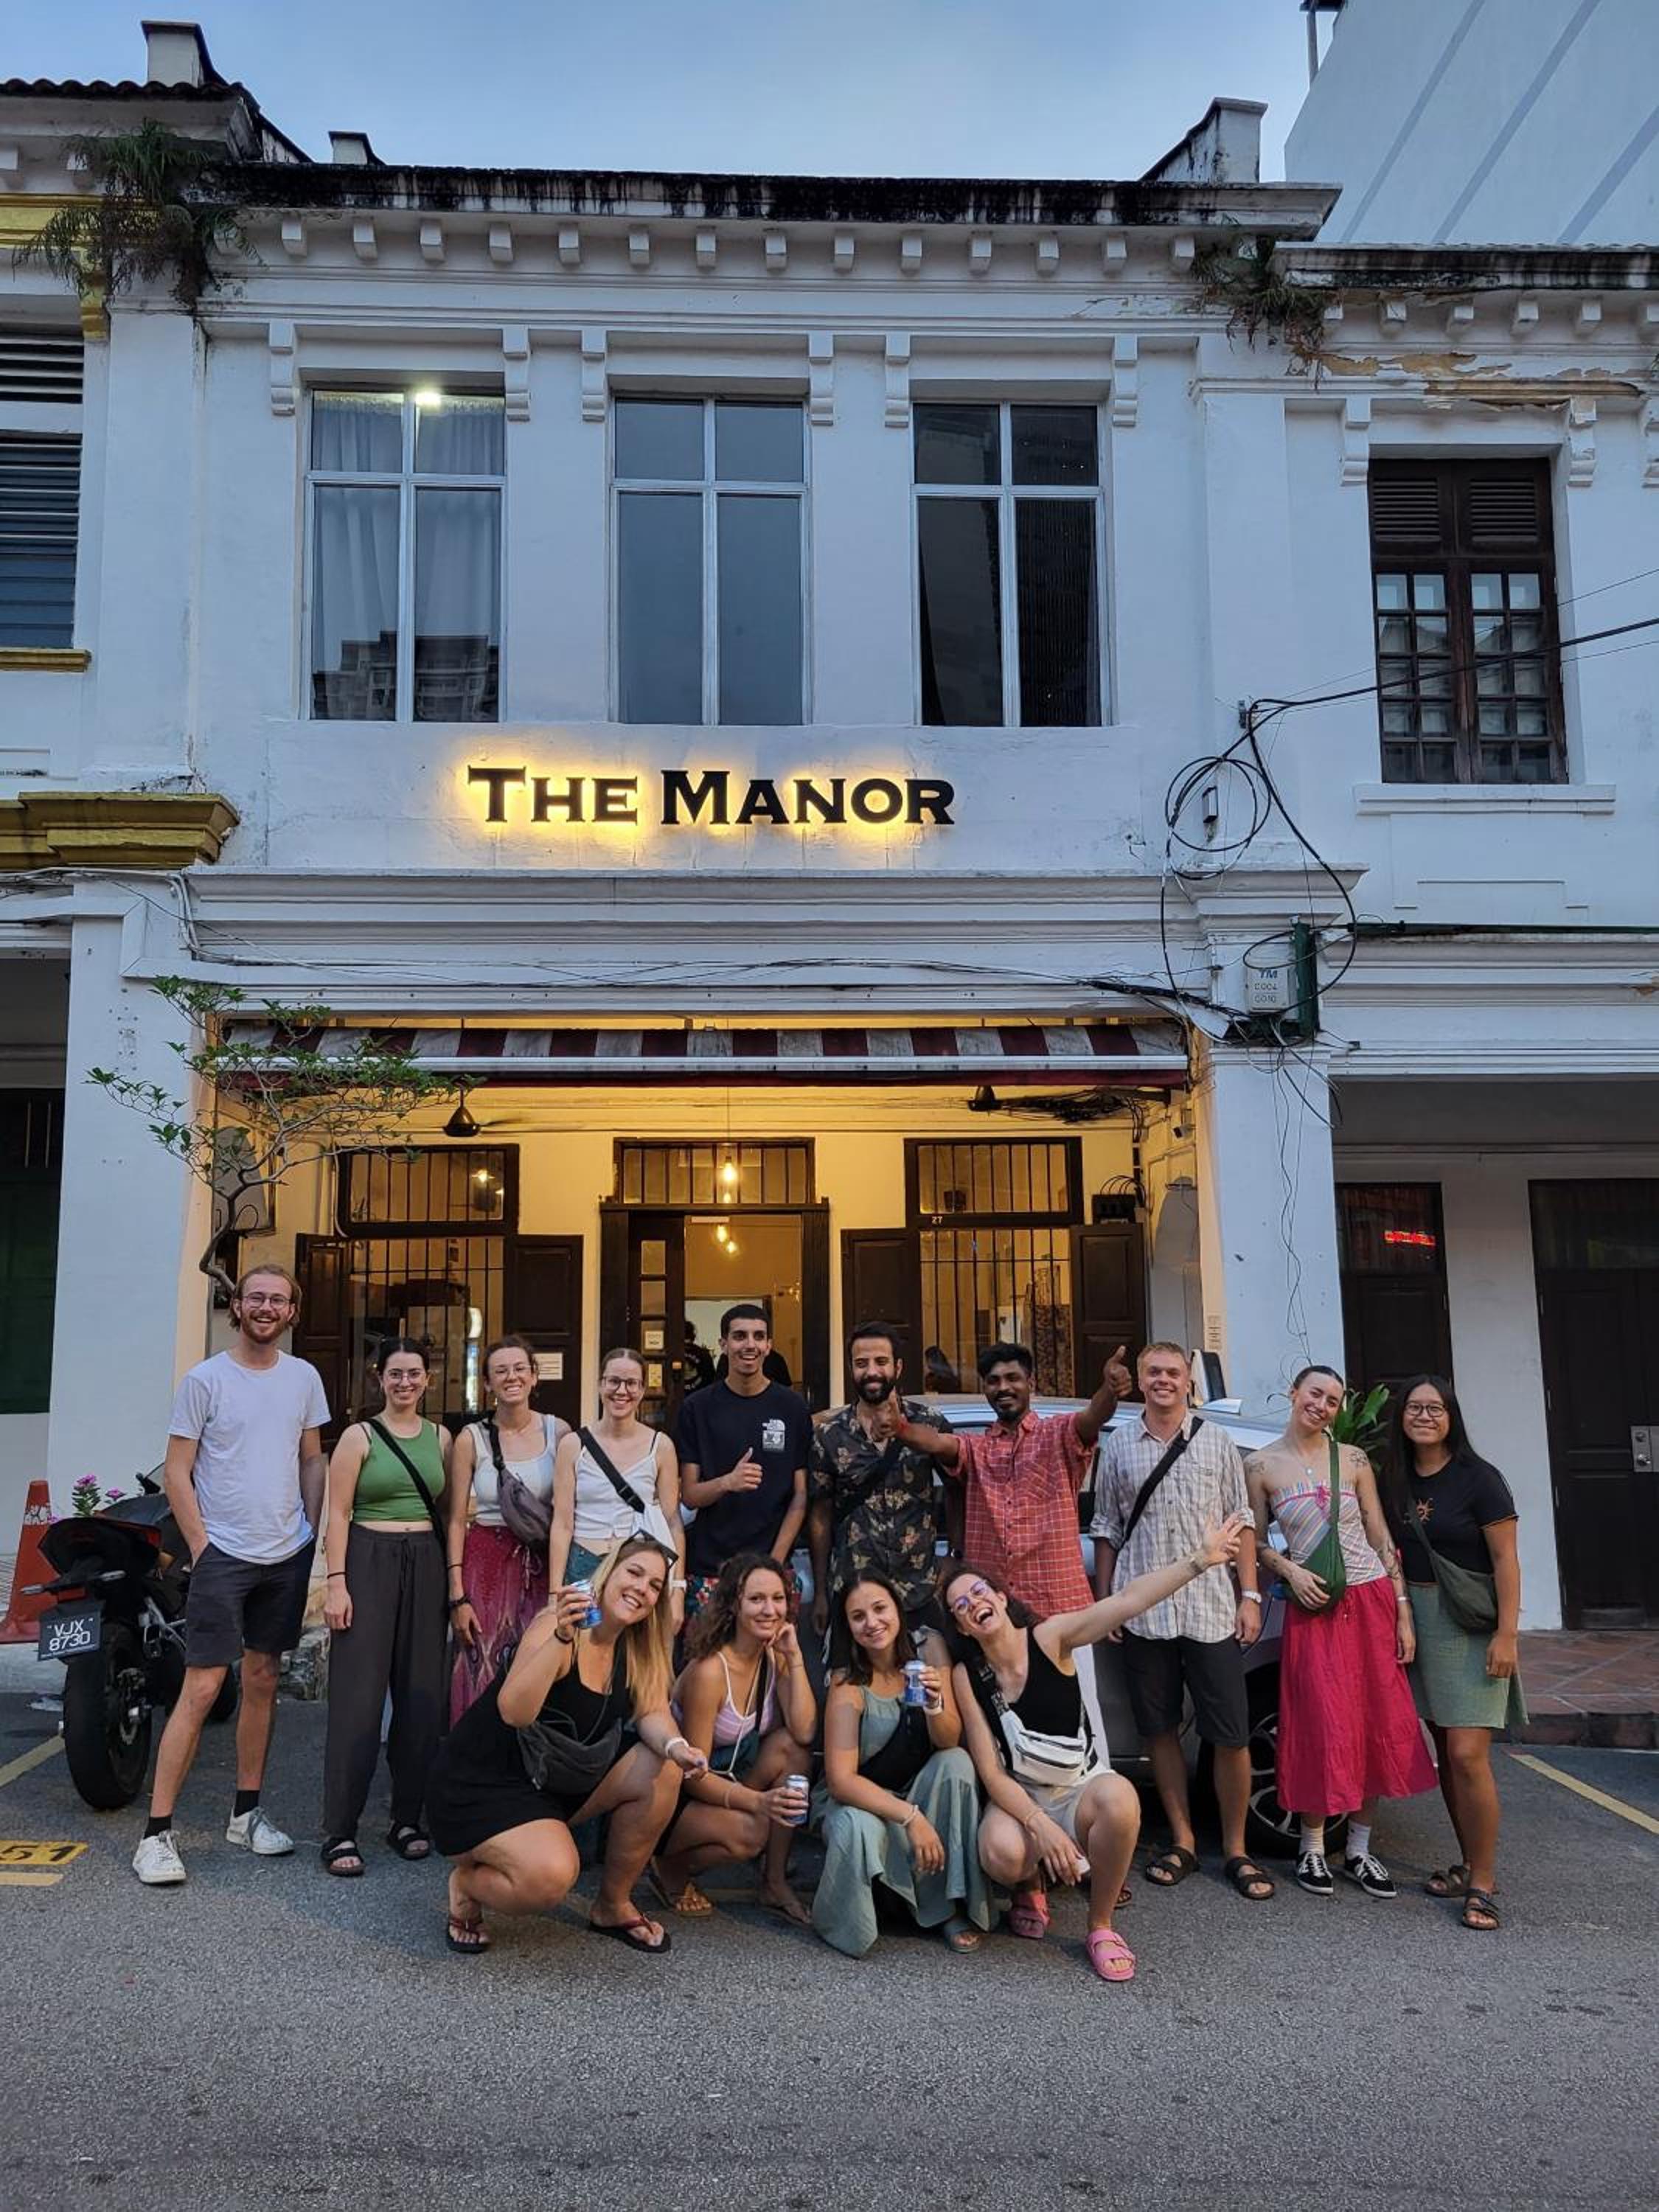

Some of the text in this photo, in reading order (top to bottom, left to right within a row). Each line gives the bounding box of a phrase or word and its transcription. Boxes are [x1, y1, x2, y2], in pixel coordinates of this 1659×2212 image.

[661, 769, 955, 825] MANOR
[54, 1618, 85, 1637] VJX
[49, 1630, 91, 1652] 8730
